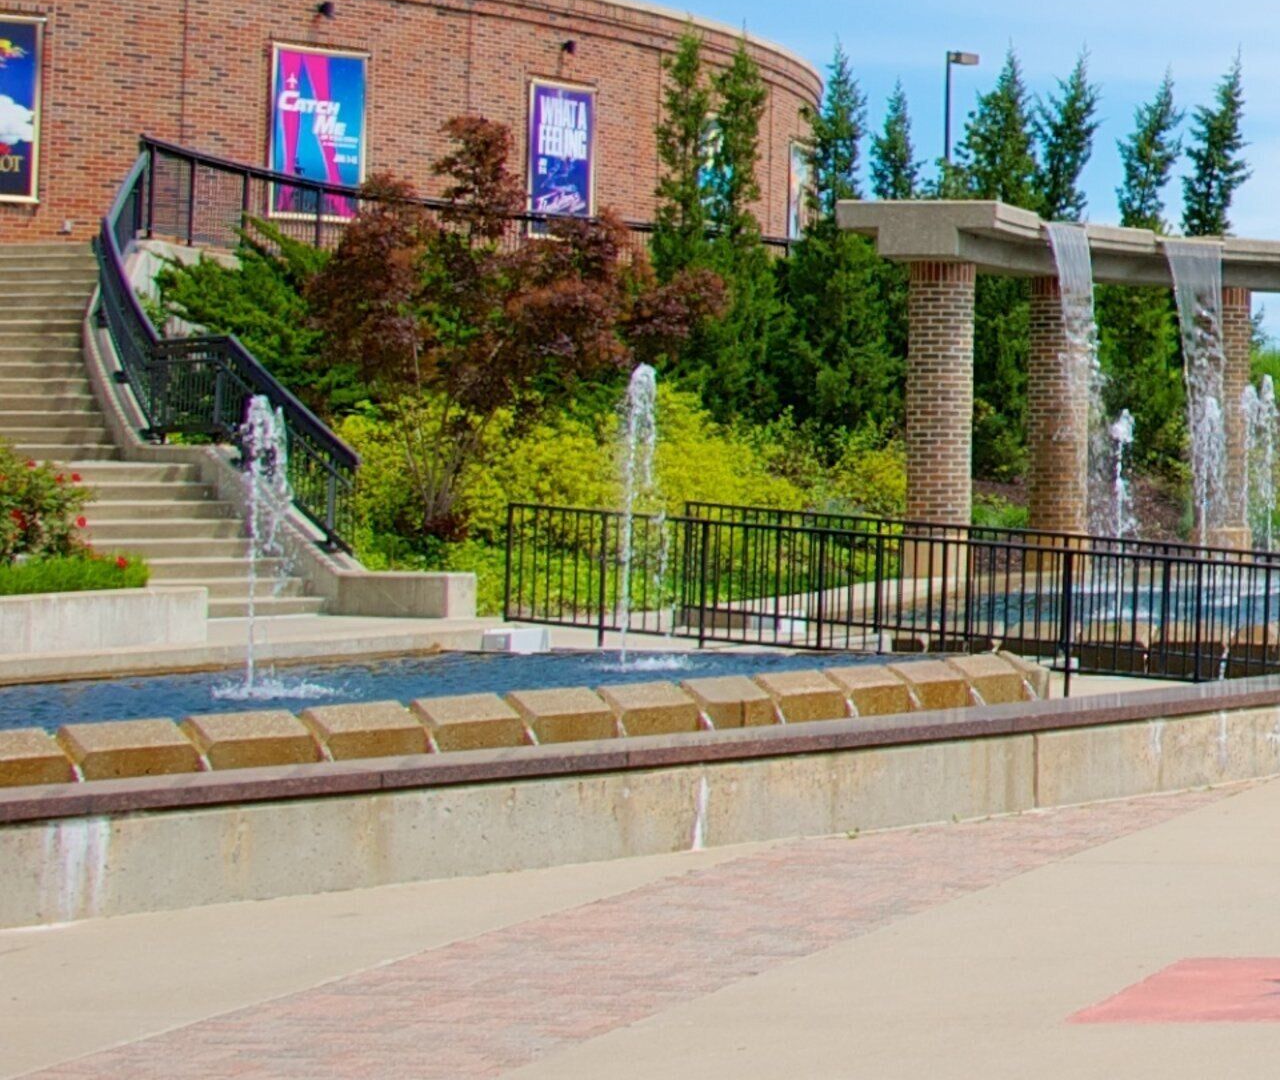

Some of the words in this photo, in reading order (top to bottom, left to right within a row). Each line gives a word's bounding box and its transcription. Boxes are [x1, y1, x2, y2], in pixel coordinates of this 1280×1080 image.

[541, 95, 578, 129] WHAT
[577, 102, 587, 130] A
[538, 123, 587, 160] FEELING
